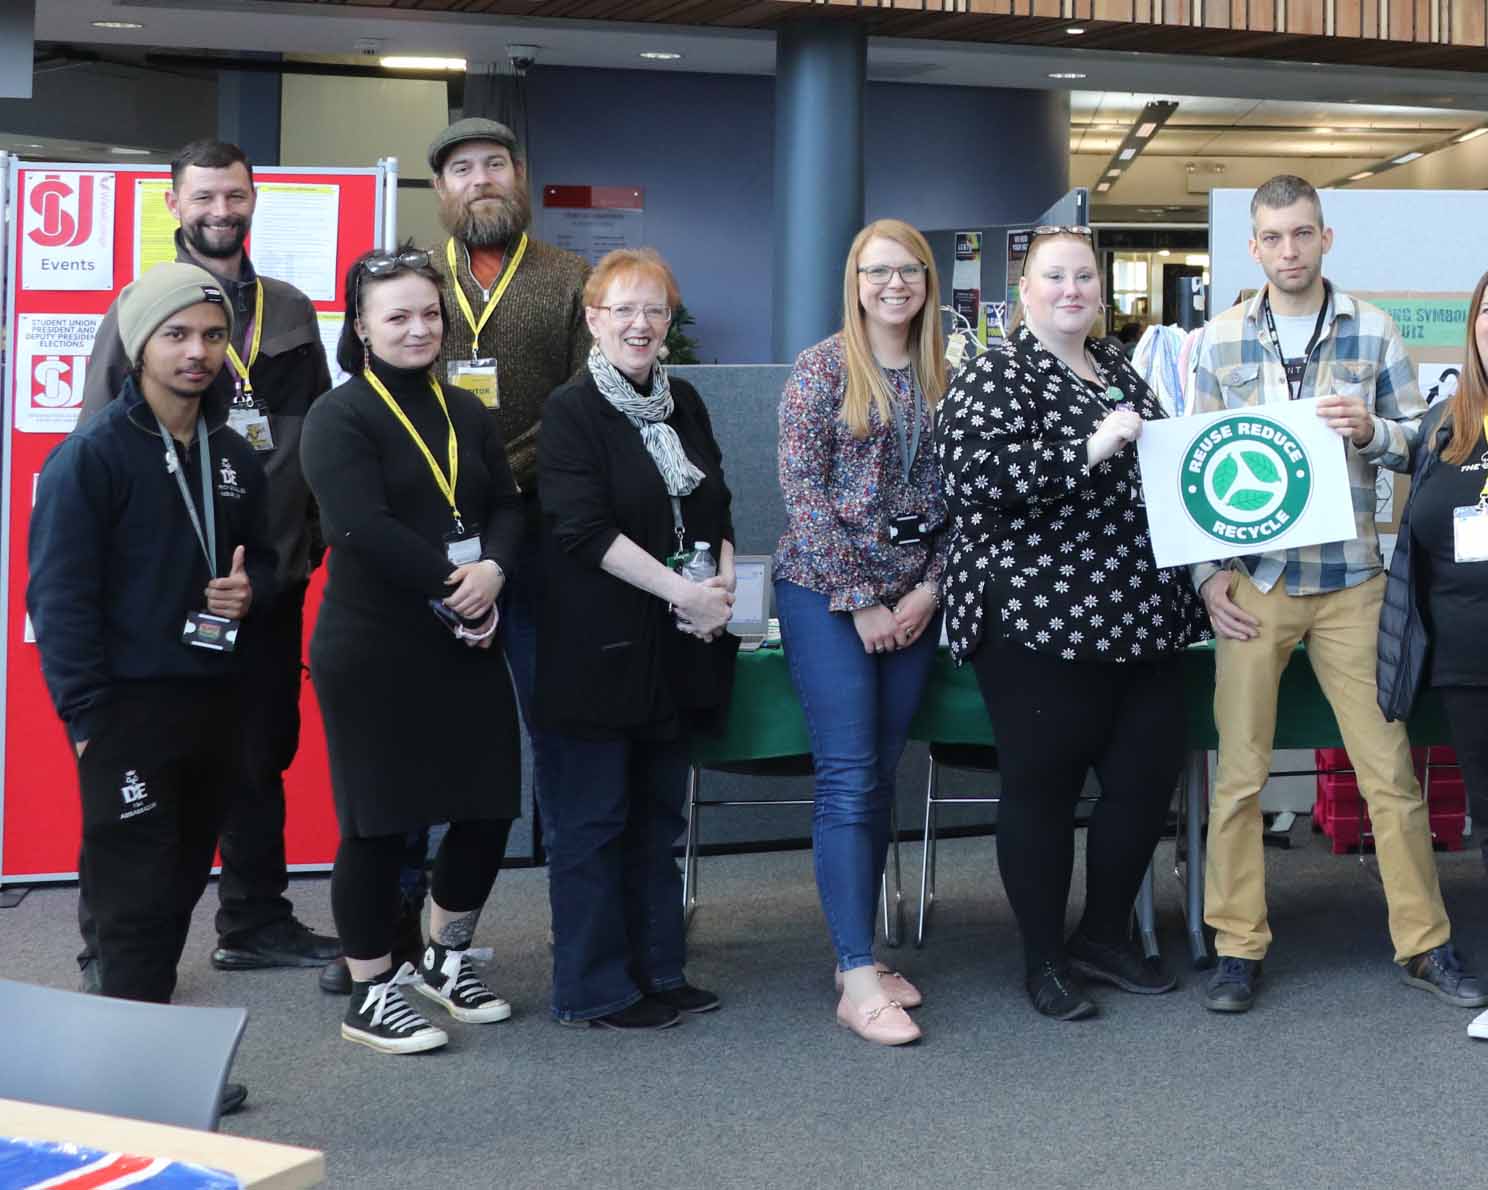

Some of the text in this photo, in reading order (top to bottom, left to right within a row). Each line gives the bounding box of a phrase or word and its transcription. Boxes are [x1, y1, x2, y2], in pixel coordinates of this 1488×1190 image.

[41, 258, 95, 271] Events
[1400, 323, 1425, 339] UIZ
[40, 340, 84, 348] ELECTIONS
[1189, 422, 1303, 474] REUSE REDUCE
[1460, 463, 1480, 473] THE
[1212, 509, 1291, 540] RECYCLE
